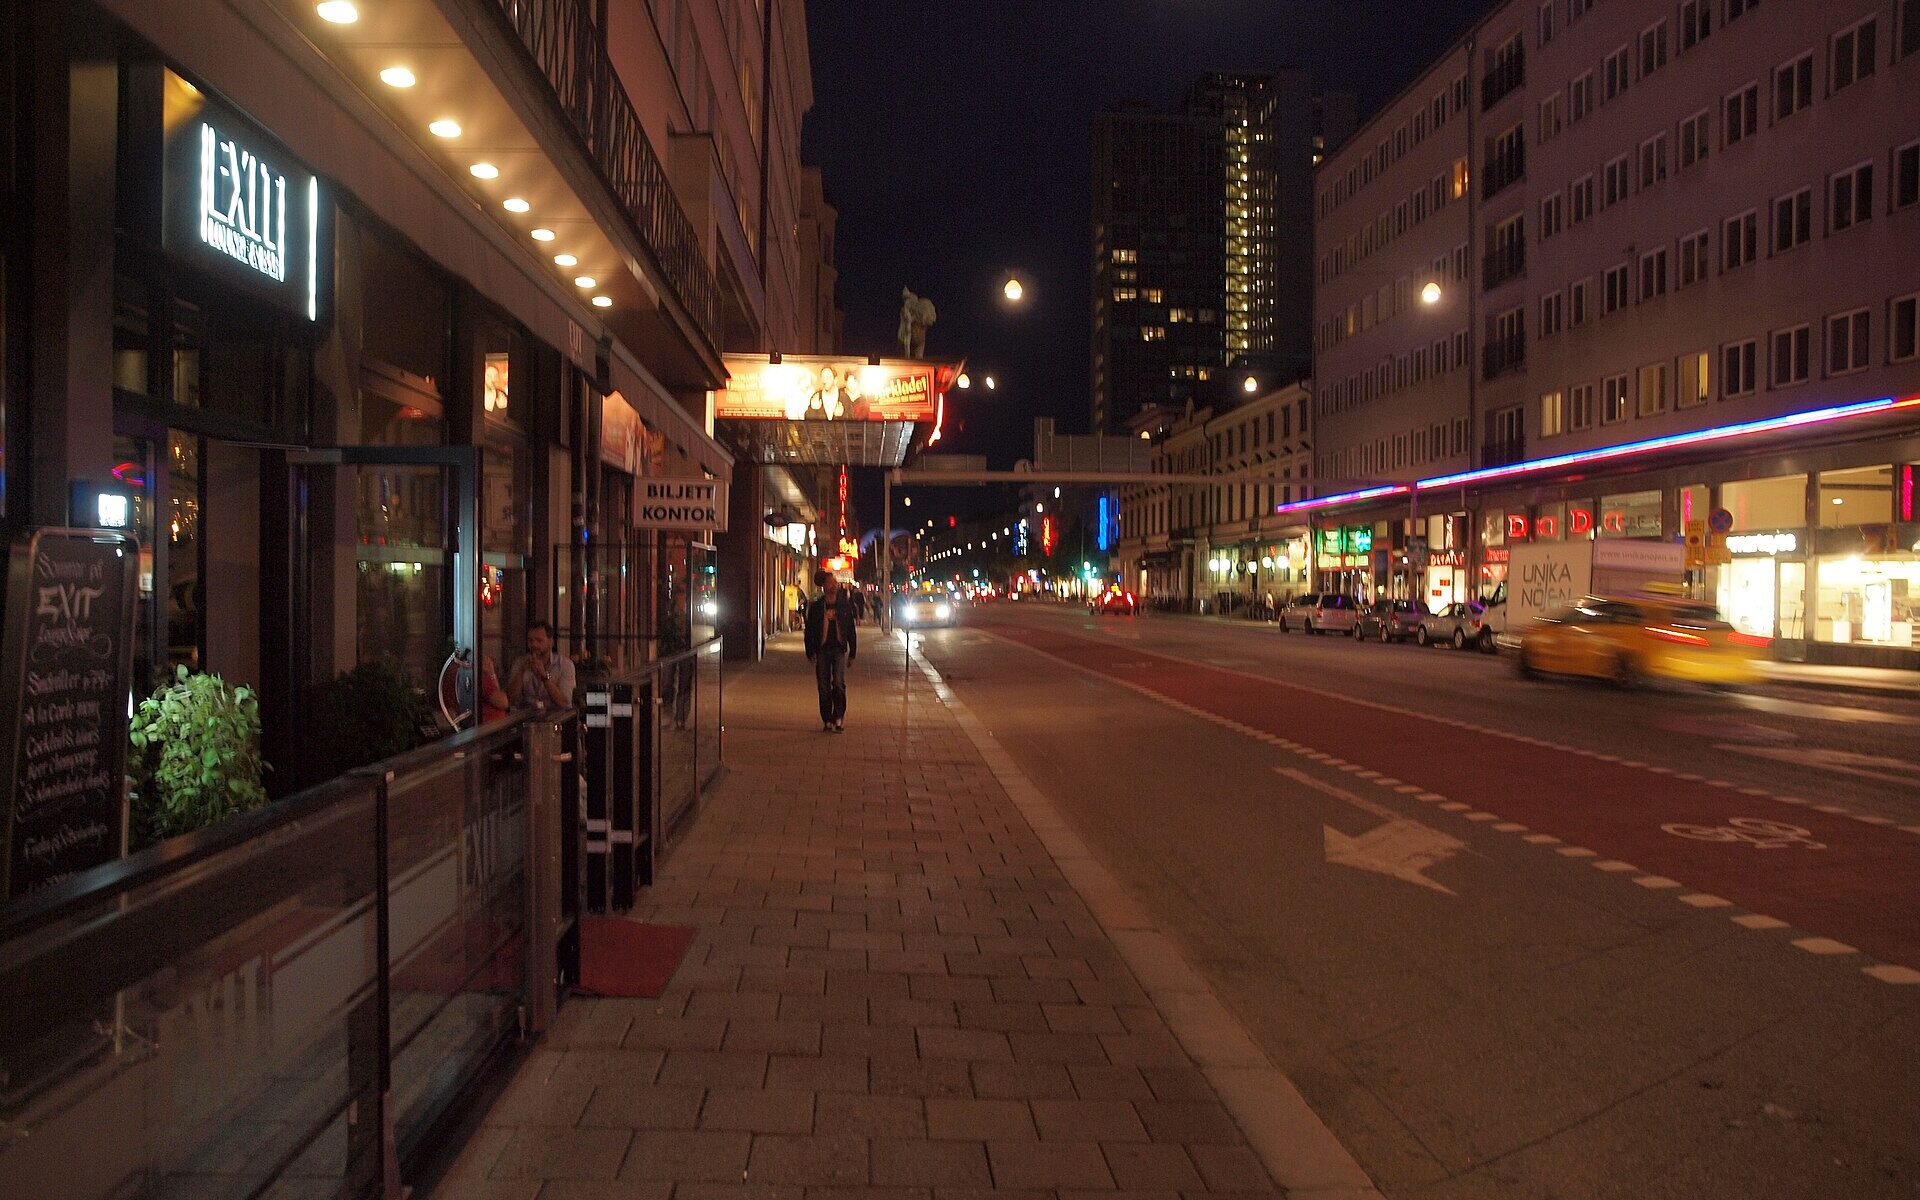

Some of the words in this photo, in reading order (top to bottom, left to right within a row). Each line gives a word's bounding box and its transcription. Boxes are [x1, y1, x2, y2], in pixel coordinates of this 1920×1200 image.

[646, 483, 714, 499] BILJETT
[641, 506, 717, 522] KONTOR
[37, 583, 106, 625] EXIT
